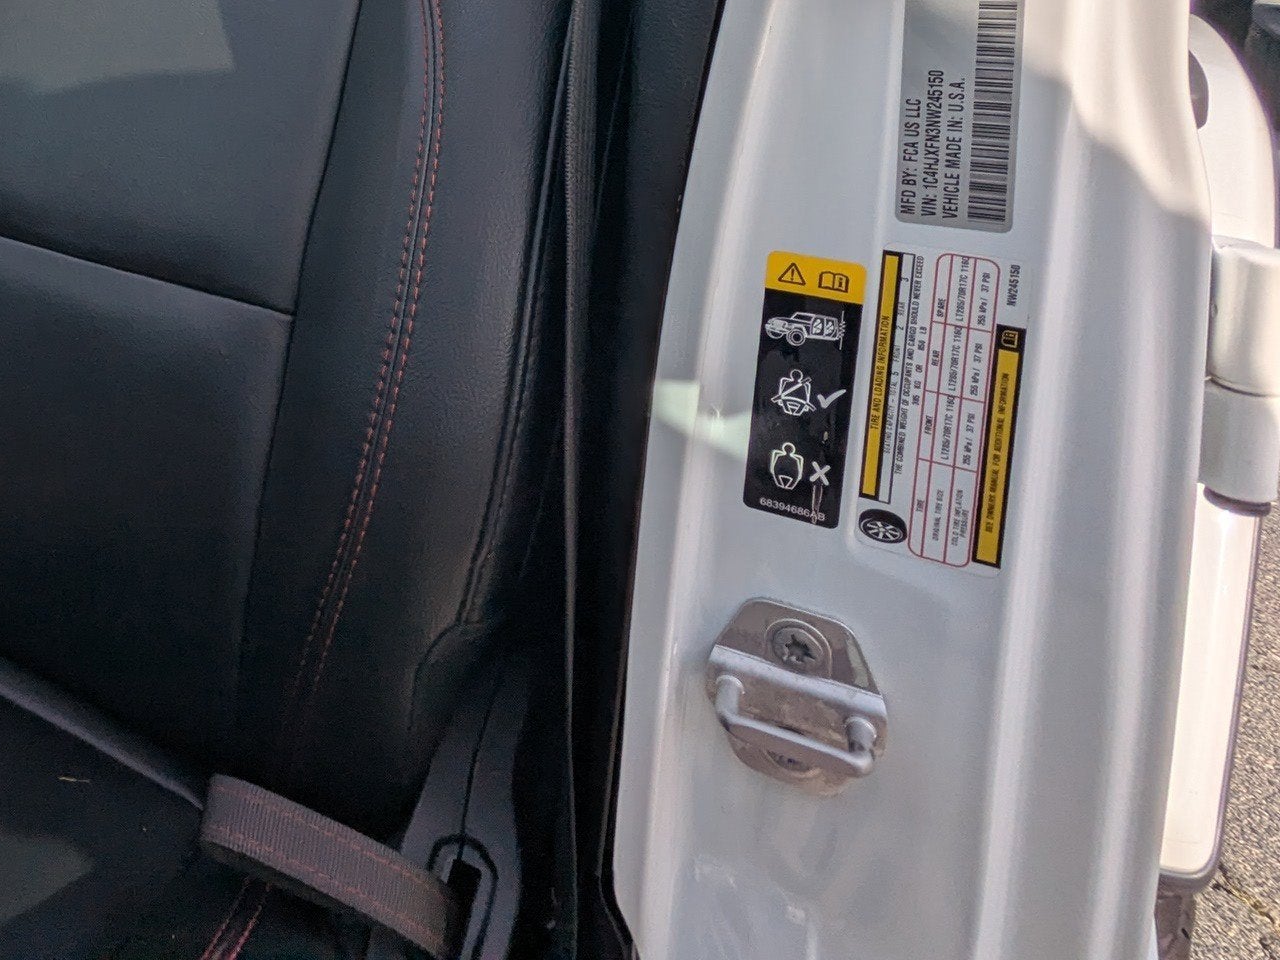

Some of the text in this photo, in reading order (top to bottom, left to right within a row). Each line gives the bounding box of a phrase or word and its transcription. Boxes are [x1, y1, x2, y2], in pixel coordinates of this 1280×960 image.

[900, 99, 921, 214] MFD BY: FCA US LLC
[921, 70, 944, 216] VIN: 1C4HJXFN3NW245150
[943, 78, 965, 218] VEHICLE MADE IN: U.S.A.
[936, 298, 945, 317] SPARE
[1007, 265, 1020, 307] NW245150
[870, 316, 889, 430] TIRE AND LOADING INFORMATION
[931, 350, 939, 366] REAR
[924, 415, 932, 435] FRONT
